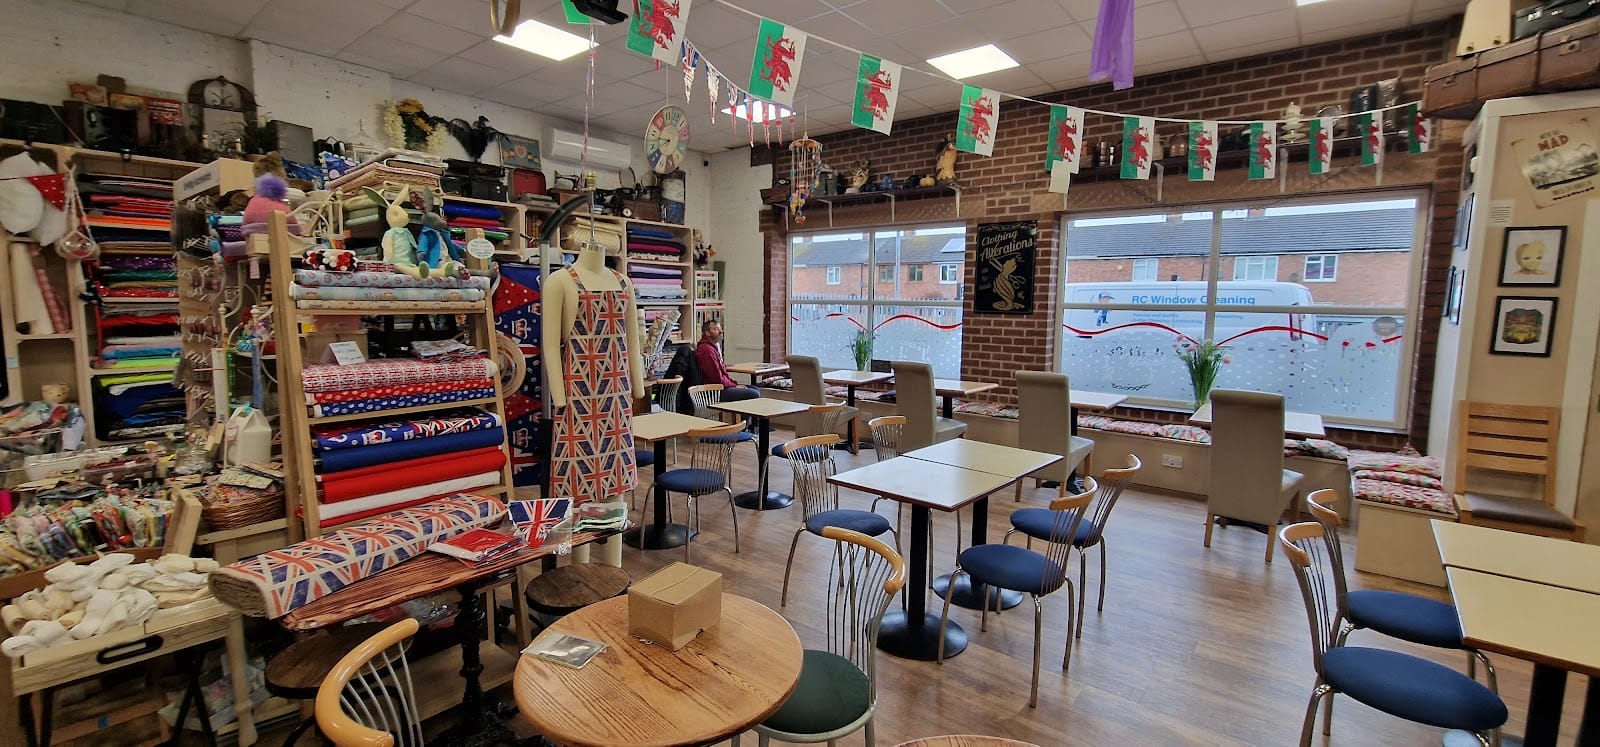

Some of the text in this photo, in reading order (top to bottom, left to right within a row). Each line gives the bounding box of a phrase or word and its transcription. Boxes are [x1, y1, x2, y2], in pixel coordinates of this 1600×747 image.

[1537, 134, 1569, 151] MAD
[981, 230, 1018, 246] Clothing
[980, 238, 1034, 262] Alterations
[1132, 295, 1256, 305] RC Window Ceaning
